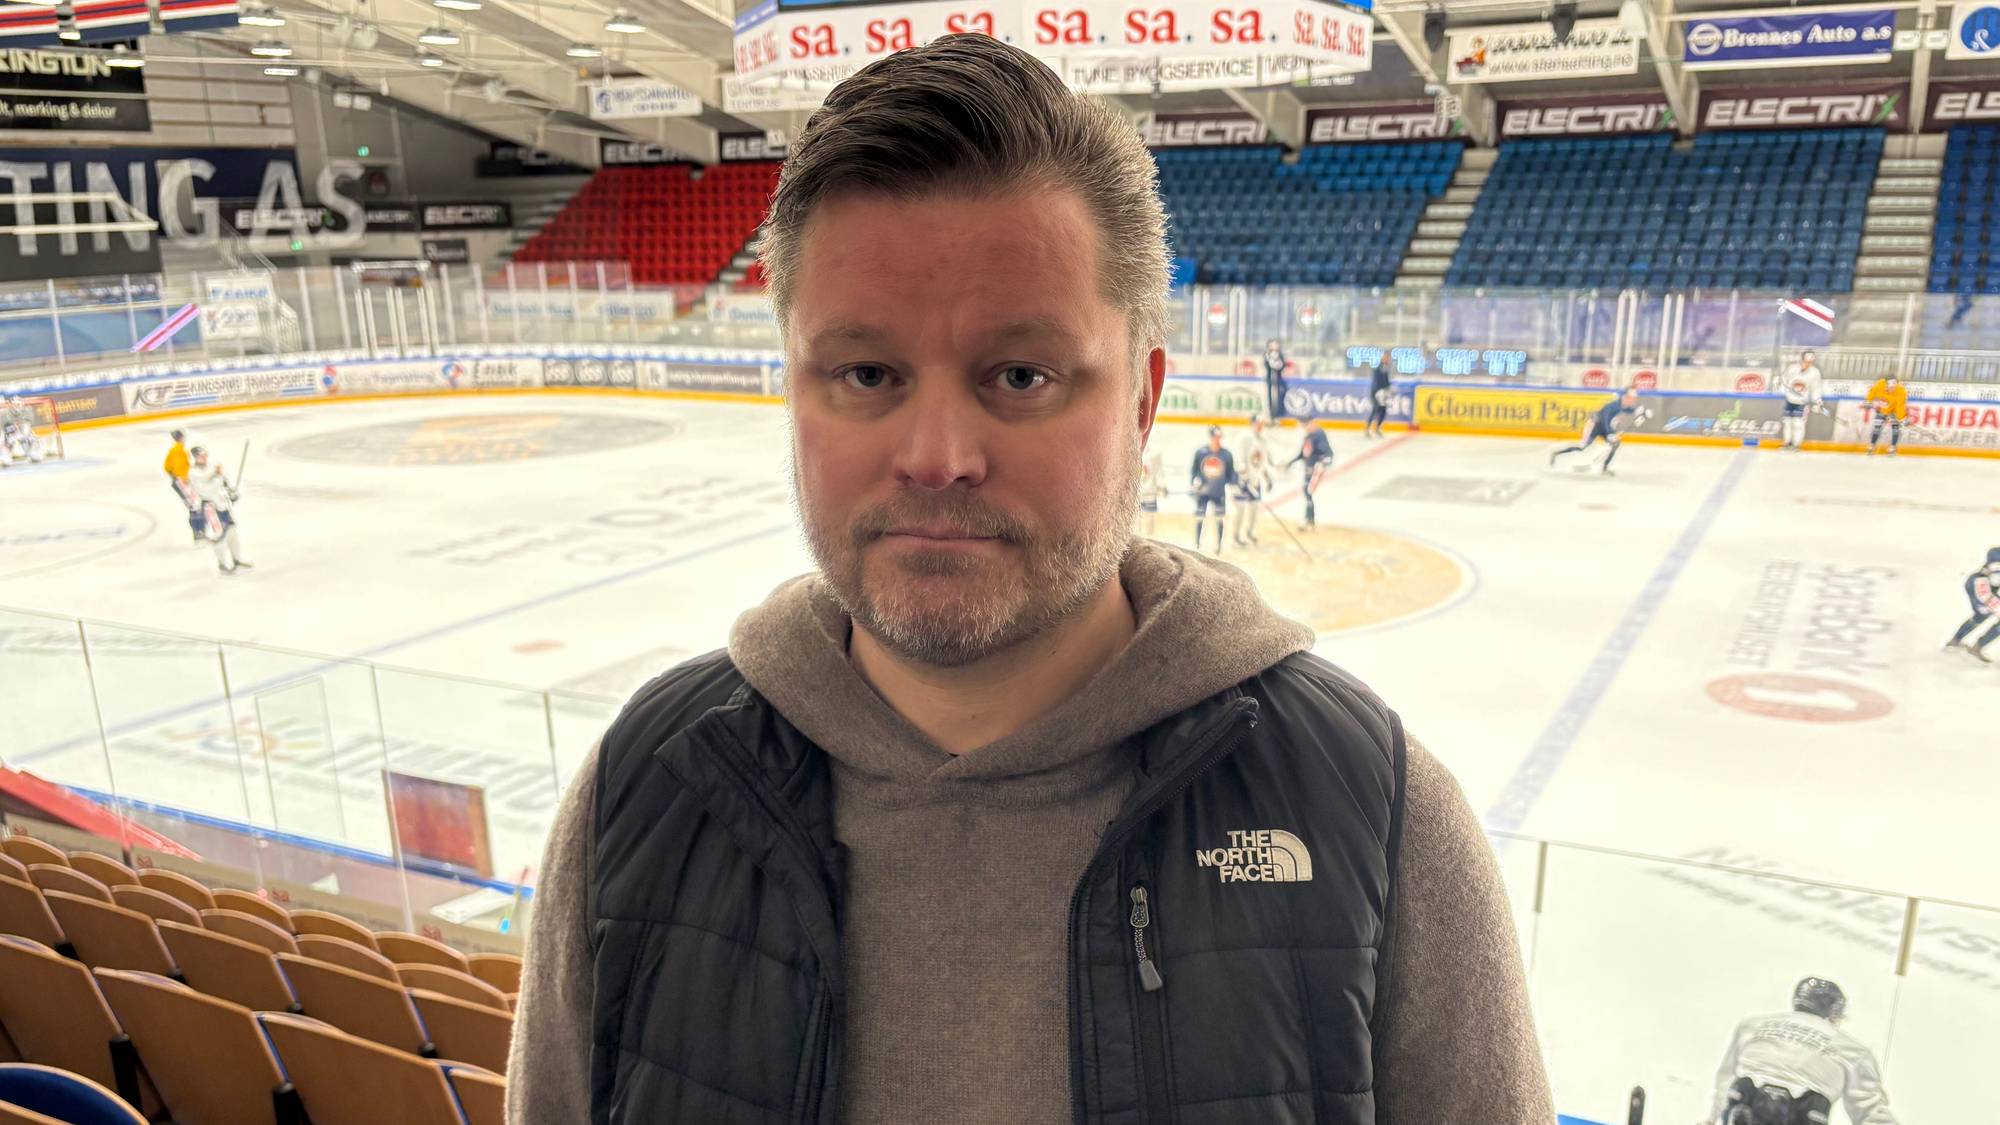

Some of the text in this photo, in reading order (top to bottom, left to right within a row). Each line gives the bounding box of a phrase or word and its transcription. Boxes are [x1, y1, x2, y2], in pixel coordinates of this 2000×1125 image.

[790, 23, 850, 59] sa.
[1035, 8, 1106, 45] sa.
[1125, 8, 1193, 44] sa.
[1211, 8, 1277, 44] sa.
[1723, 29, 1802, 48] Brennes
[1806, 24, 1857, 44] Auto
[1503, 104, 1678, 135] ELECTRIX
[1704, 94, 1899, 126] ELECTRIX
[1146, 120, 1270, 145] ELECTRI
[251, 158, 367, 247] AS
[1425, 393, 1531, 420] Glomma
[1859, 404, 1999, 429] TSHIBA
[1227, 829, 1271, 848] THE
[1196, 847, 1272, 868] NORTH
[1220, 864, 1275, 883] FACE
